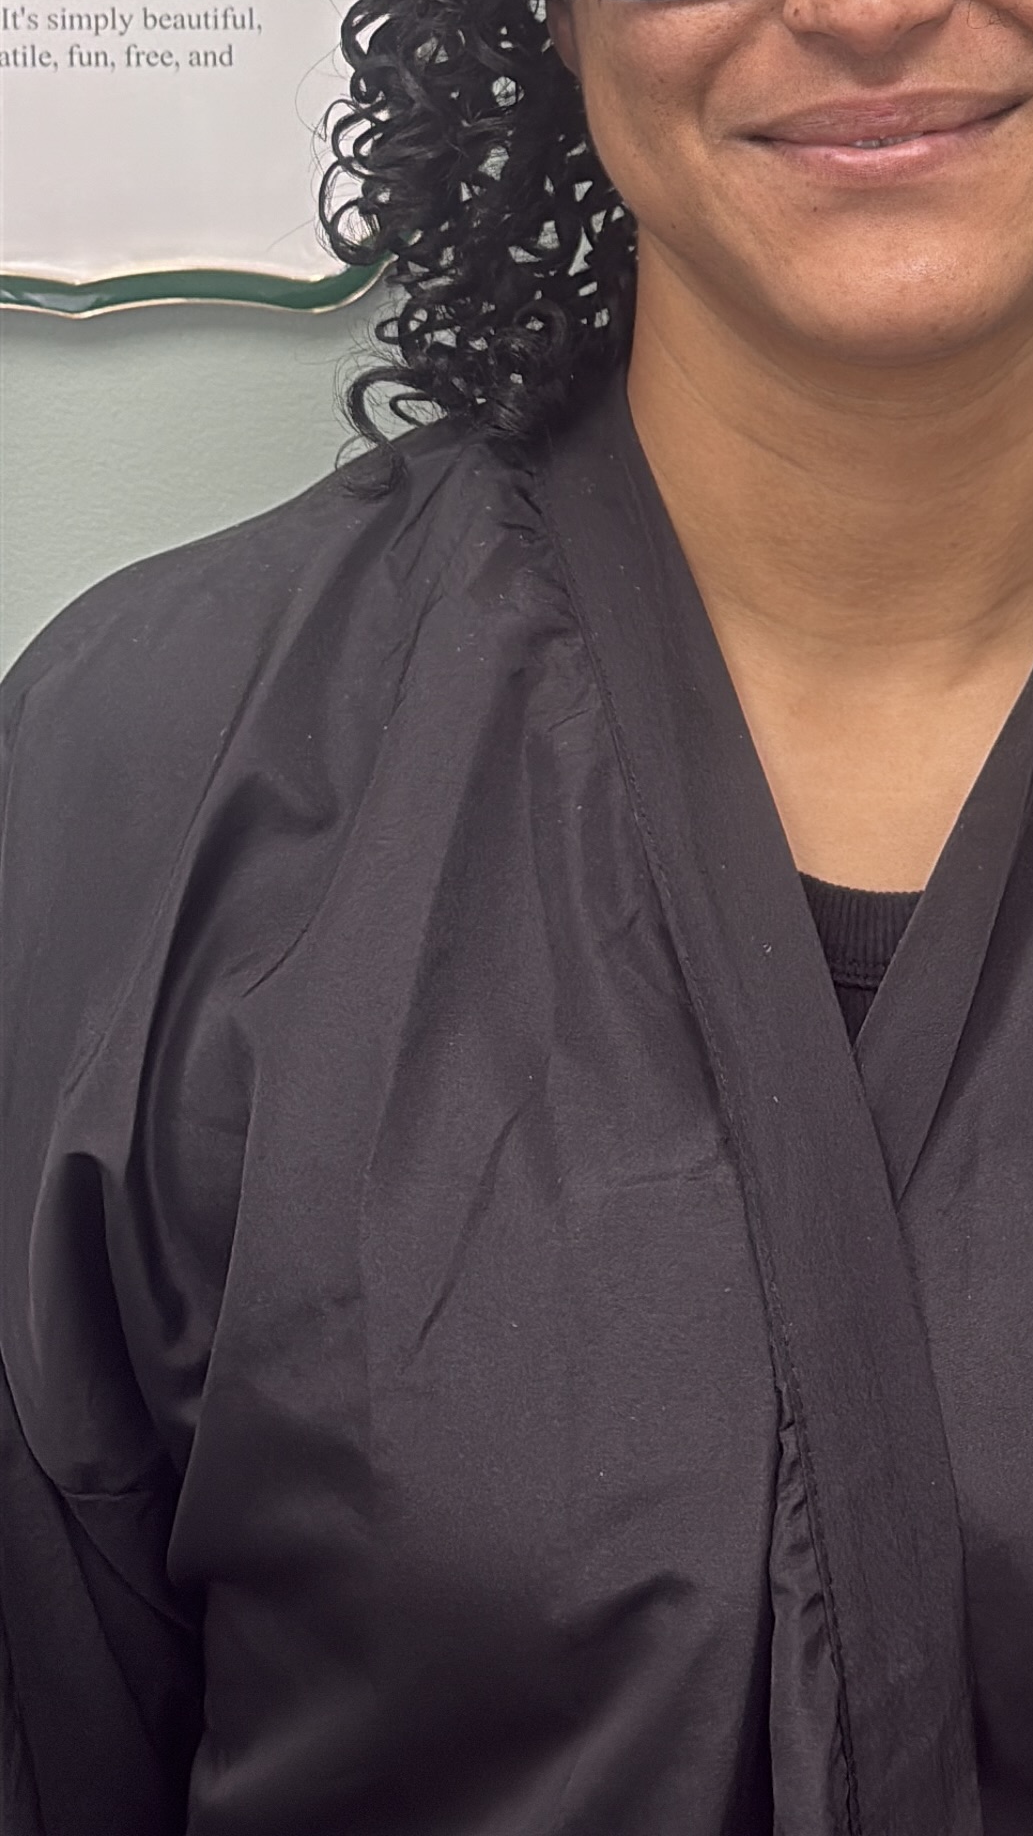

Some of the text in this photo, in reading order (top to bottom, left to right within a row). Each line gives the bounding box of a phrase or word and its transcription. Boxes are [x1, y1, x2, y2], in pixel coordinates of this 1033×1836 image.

[2, 5, 263, 37] It's simply beautiful,
[0, 43, 234, 74] atile, fun, free, and
